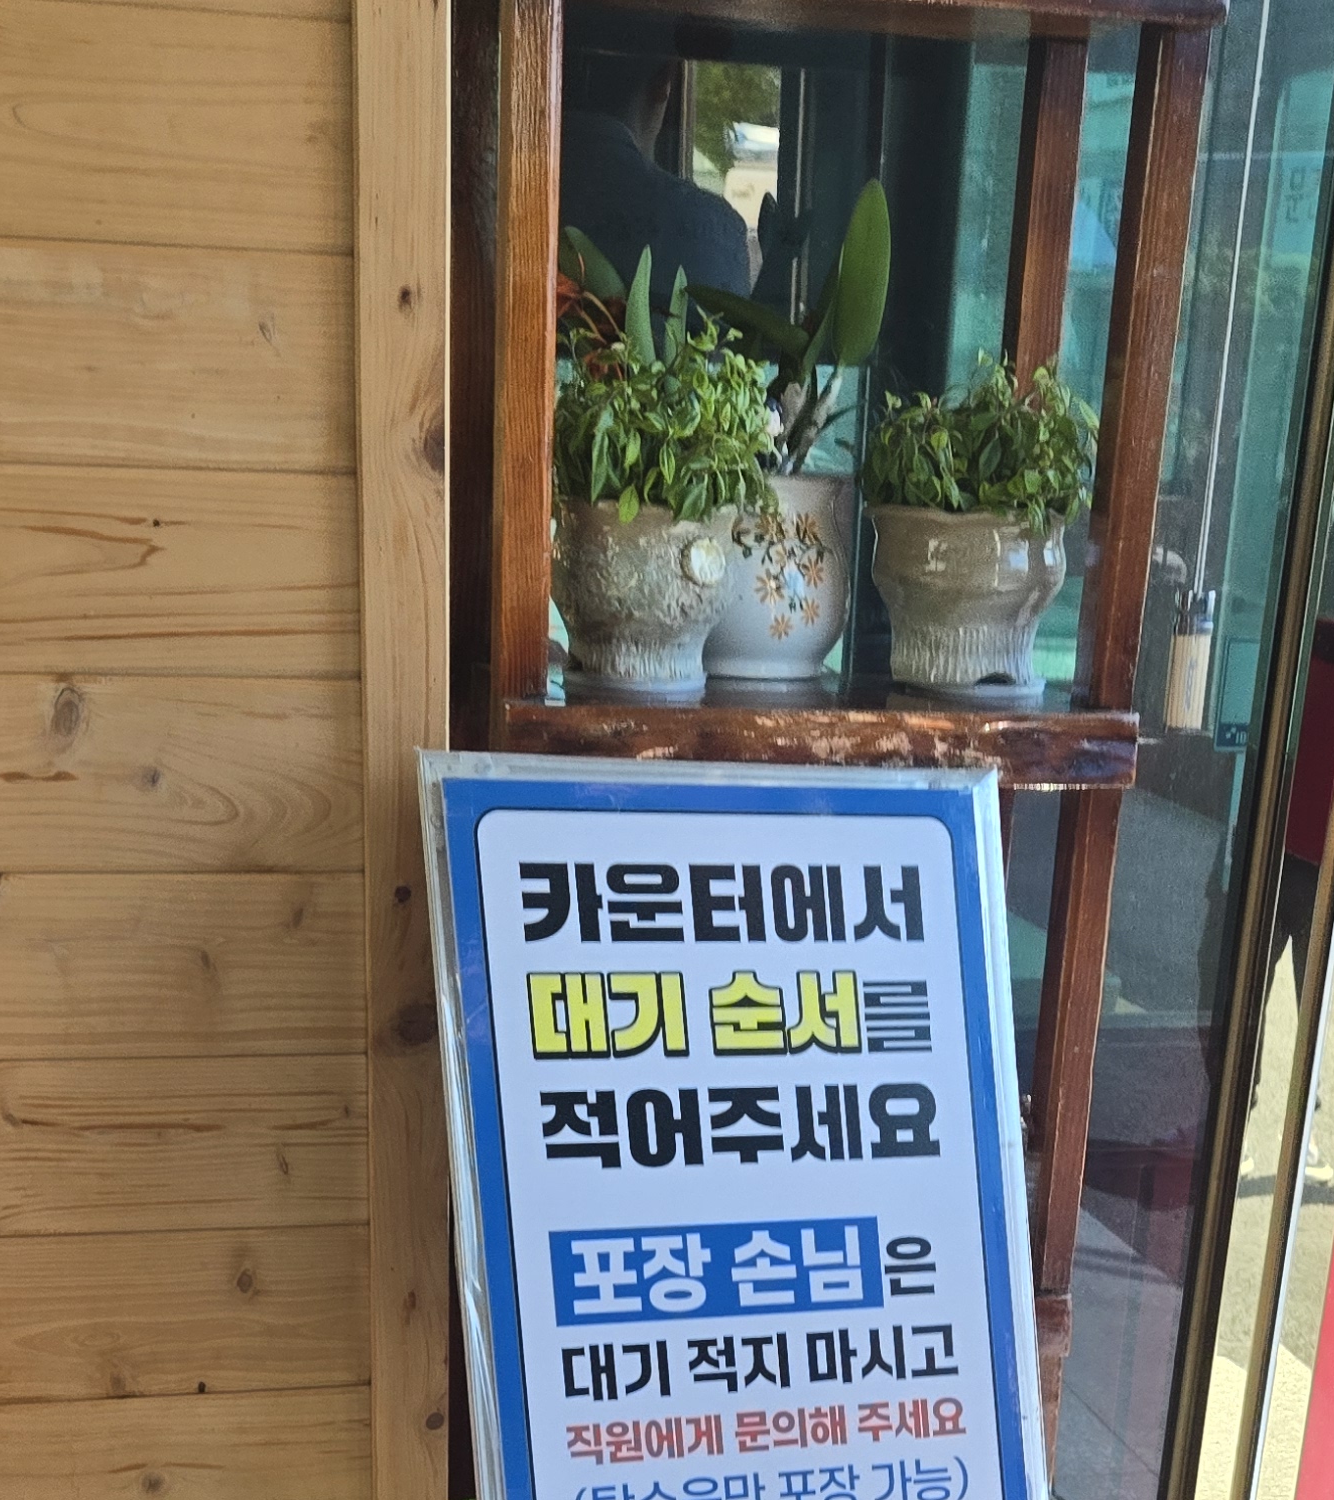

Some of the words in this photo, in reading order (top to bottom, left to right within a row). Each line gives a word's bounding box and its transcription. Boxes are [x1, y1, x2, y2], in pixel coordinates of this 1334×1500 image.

[519, 860, 925, 943] 카운터에서
[525, 971, 690, 1060] 대기
[707, 969, 934, 1057] 순서를
[539, 1082, 942, 1169] 적어주세요
[569, 1232, 711, 1316] 포장
[729, 1224, 937, 1309] 손님은
[561, 1338, 672, 1402] 대기
[687, 1332, 792, 1394] 적지
[806, 1322, 960, 1385] 마시고
[567, 1413, 724, 1466] 직원에게
[734, 1404, 848, 1455] 문의해
[857, 1396, 967, 1443] 주세요
